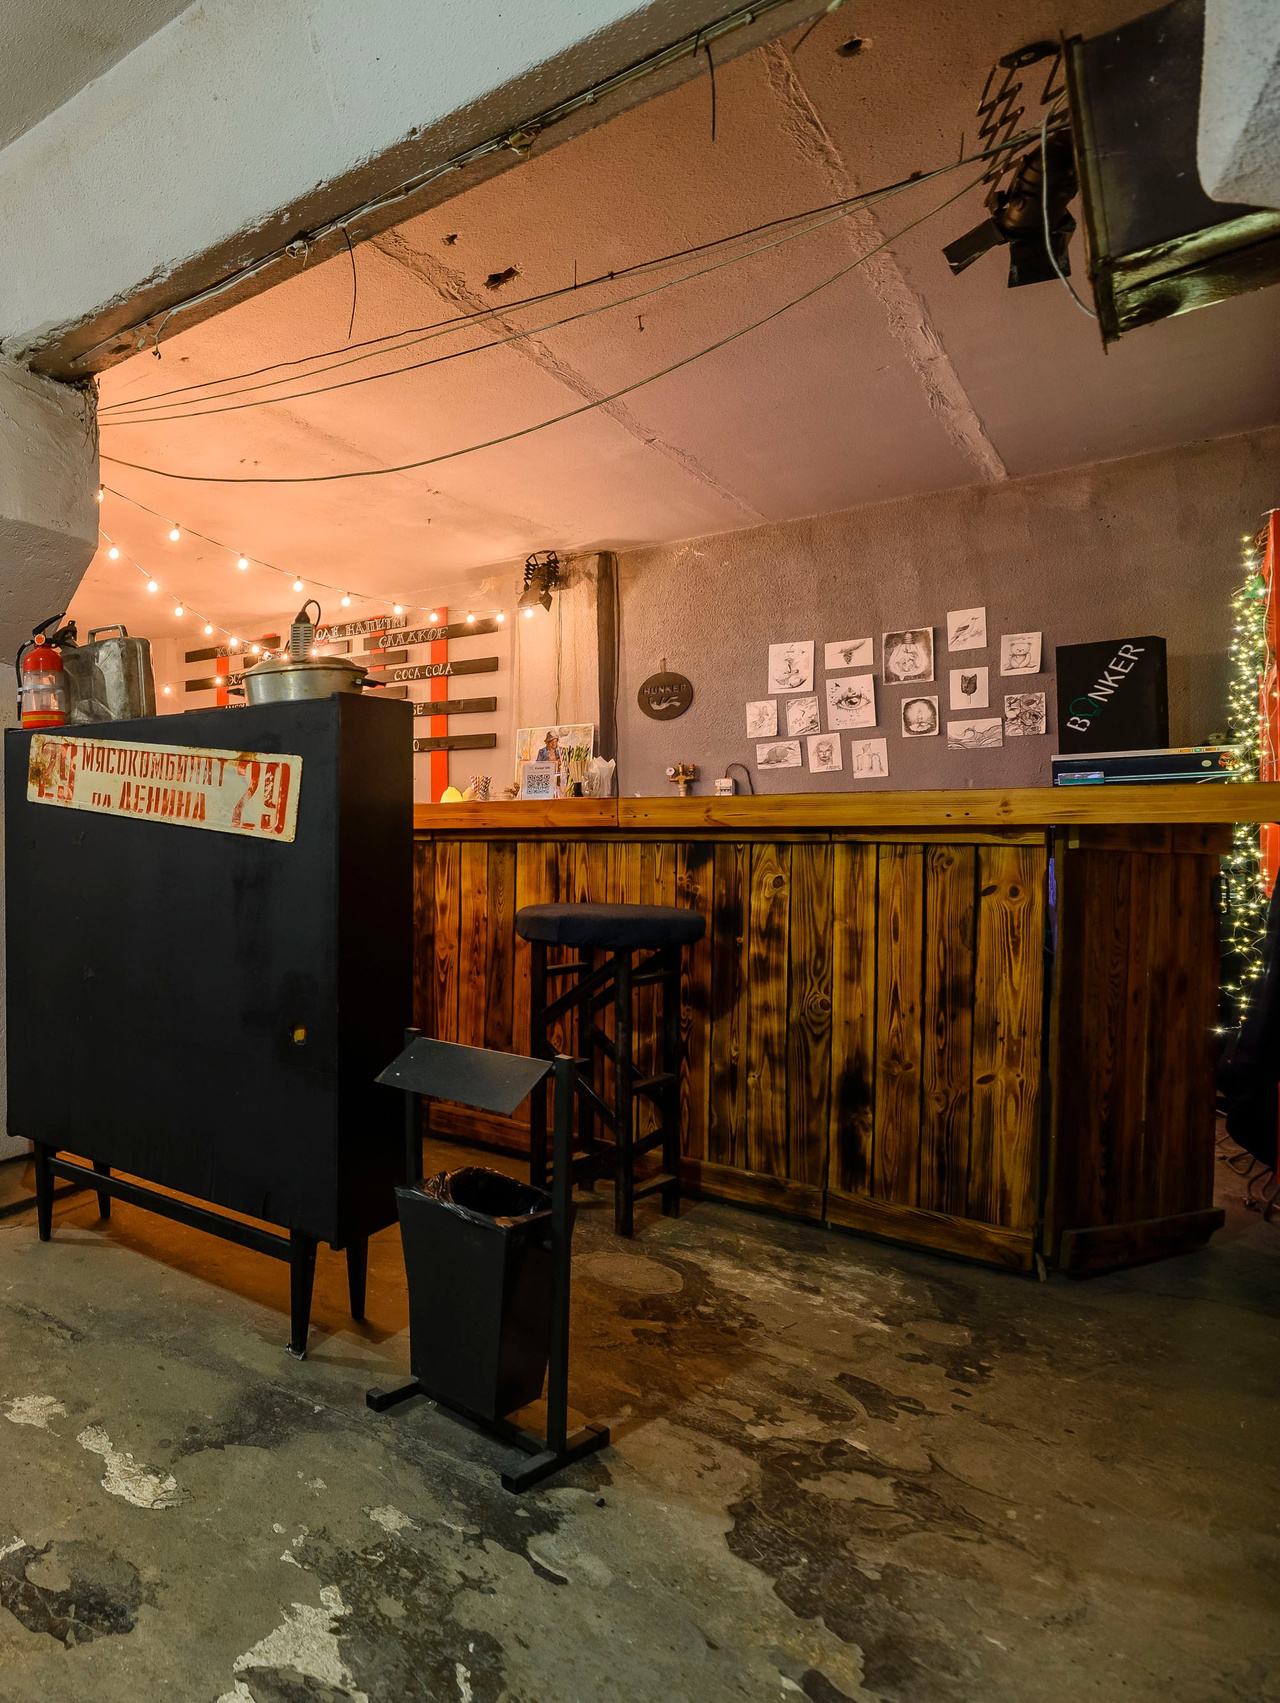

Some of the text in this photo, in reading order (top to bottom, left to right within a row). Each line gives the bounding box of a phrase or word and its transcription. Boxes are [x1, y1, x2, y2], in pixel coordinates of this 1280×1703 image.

[345, 615, 406, 636] НАПИТКИ
[378, 626, 449, 648] СЛАДКОЕ
[394, 662, 454, 681] COCA-COLA
[37, 742, 78, 801] 29
[81, 742, 225, 787] МЯСОКОМБИНАТ
[118, 781, 206, 822] ЛЕНИНА
[231, 760, 291, 835] 29
